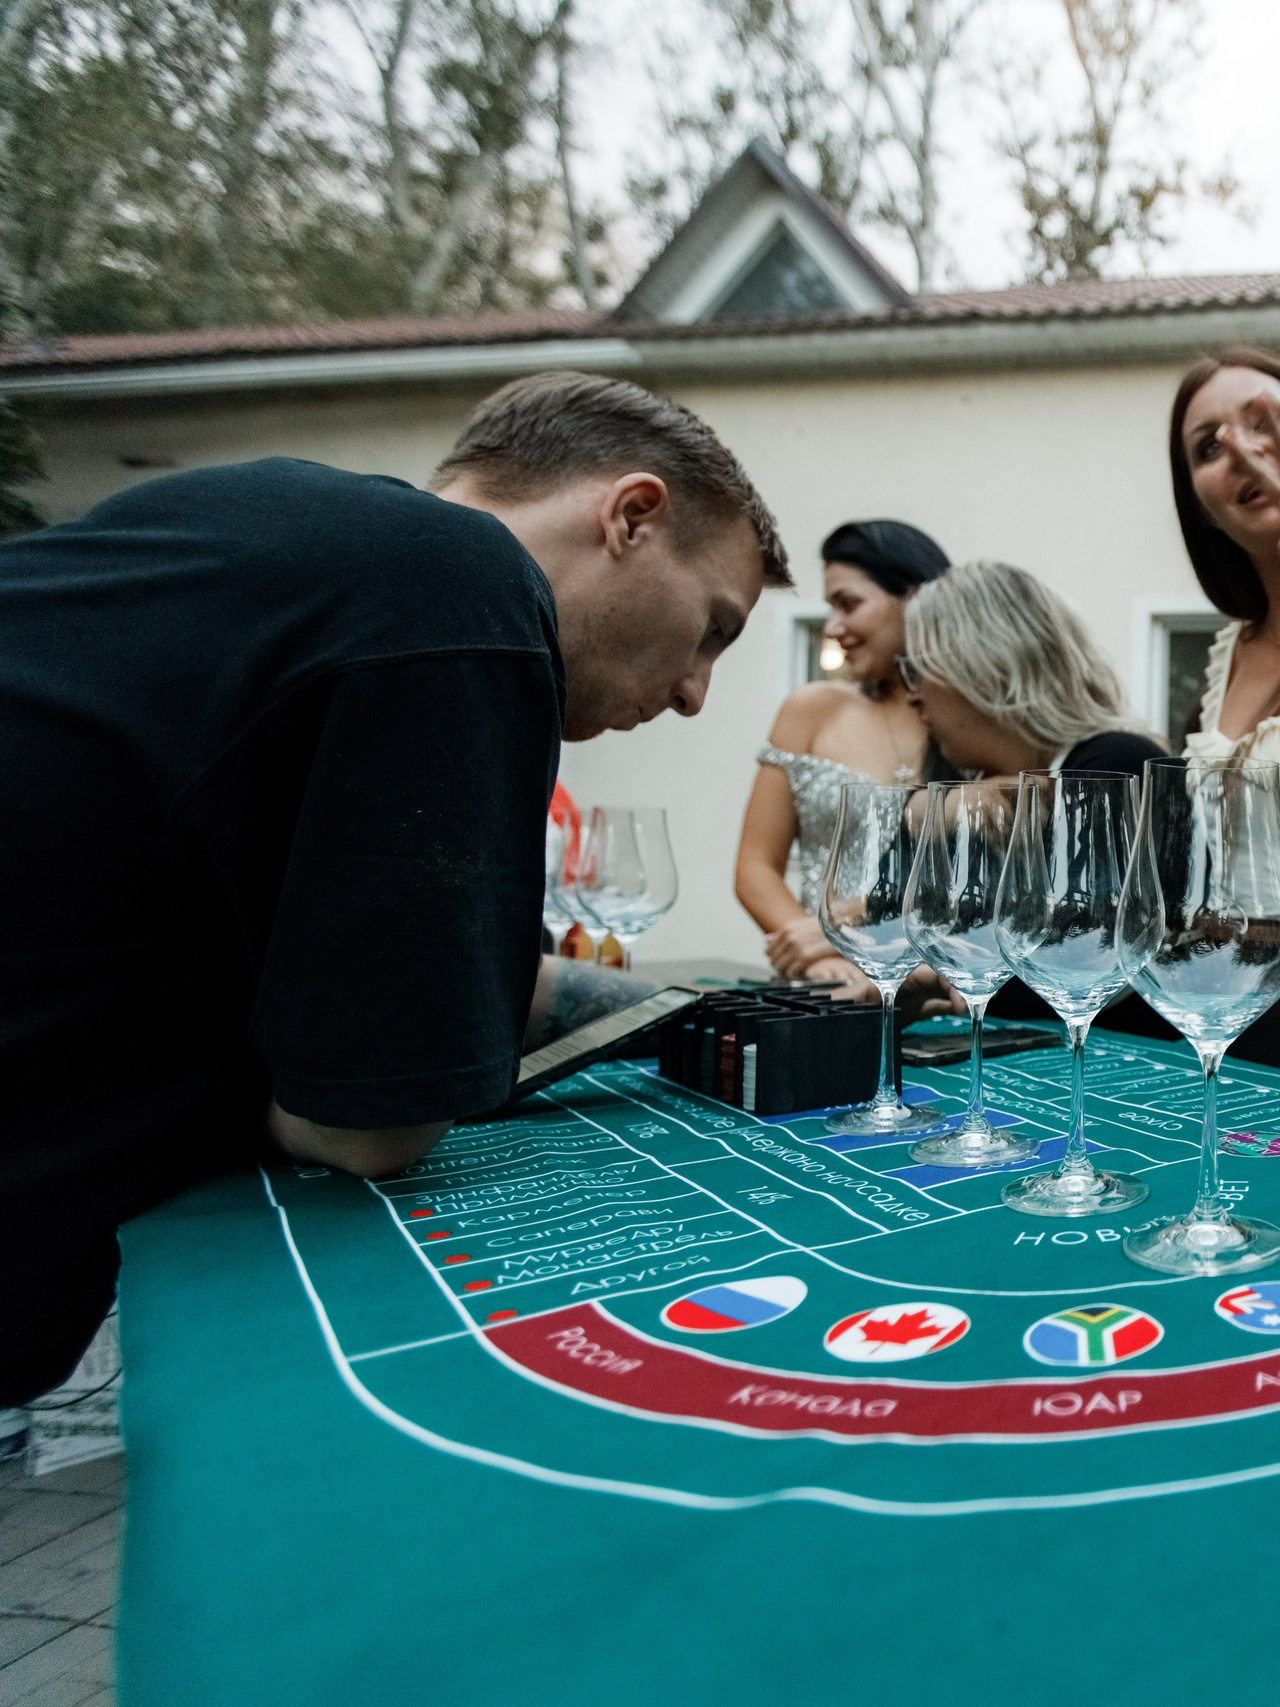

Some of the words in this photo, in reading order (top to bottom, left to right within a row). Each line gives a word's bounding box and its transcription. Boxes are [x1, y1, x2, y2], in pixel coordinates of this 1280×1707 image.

[402, 1135, 614, 1177] онтепульчано
[736, 1185, 794, 1206] 14%
[486, 1205, 674, 1248] Саперави
[571, 1253, 713, 1295] Другой
[545, 1325, 644, 1375] Россия
[726, 1383, 898, 1418] Канада
[1032, 1388, 1143, 1417] ЮАР
